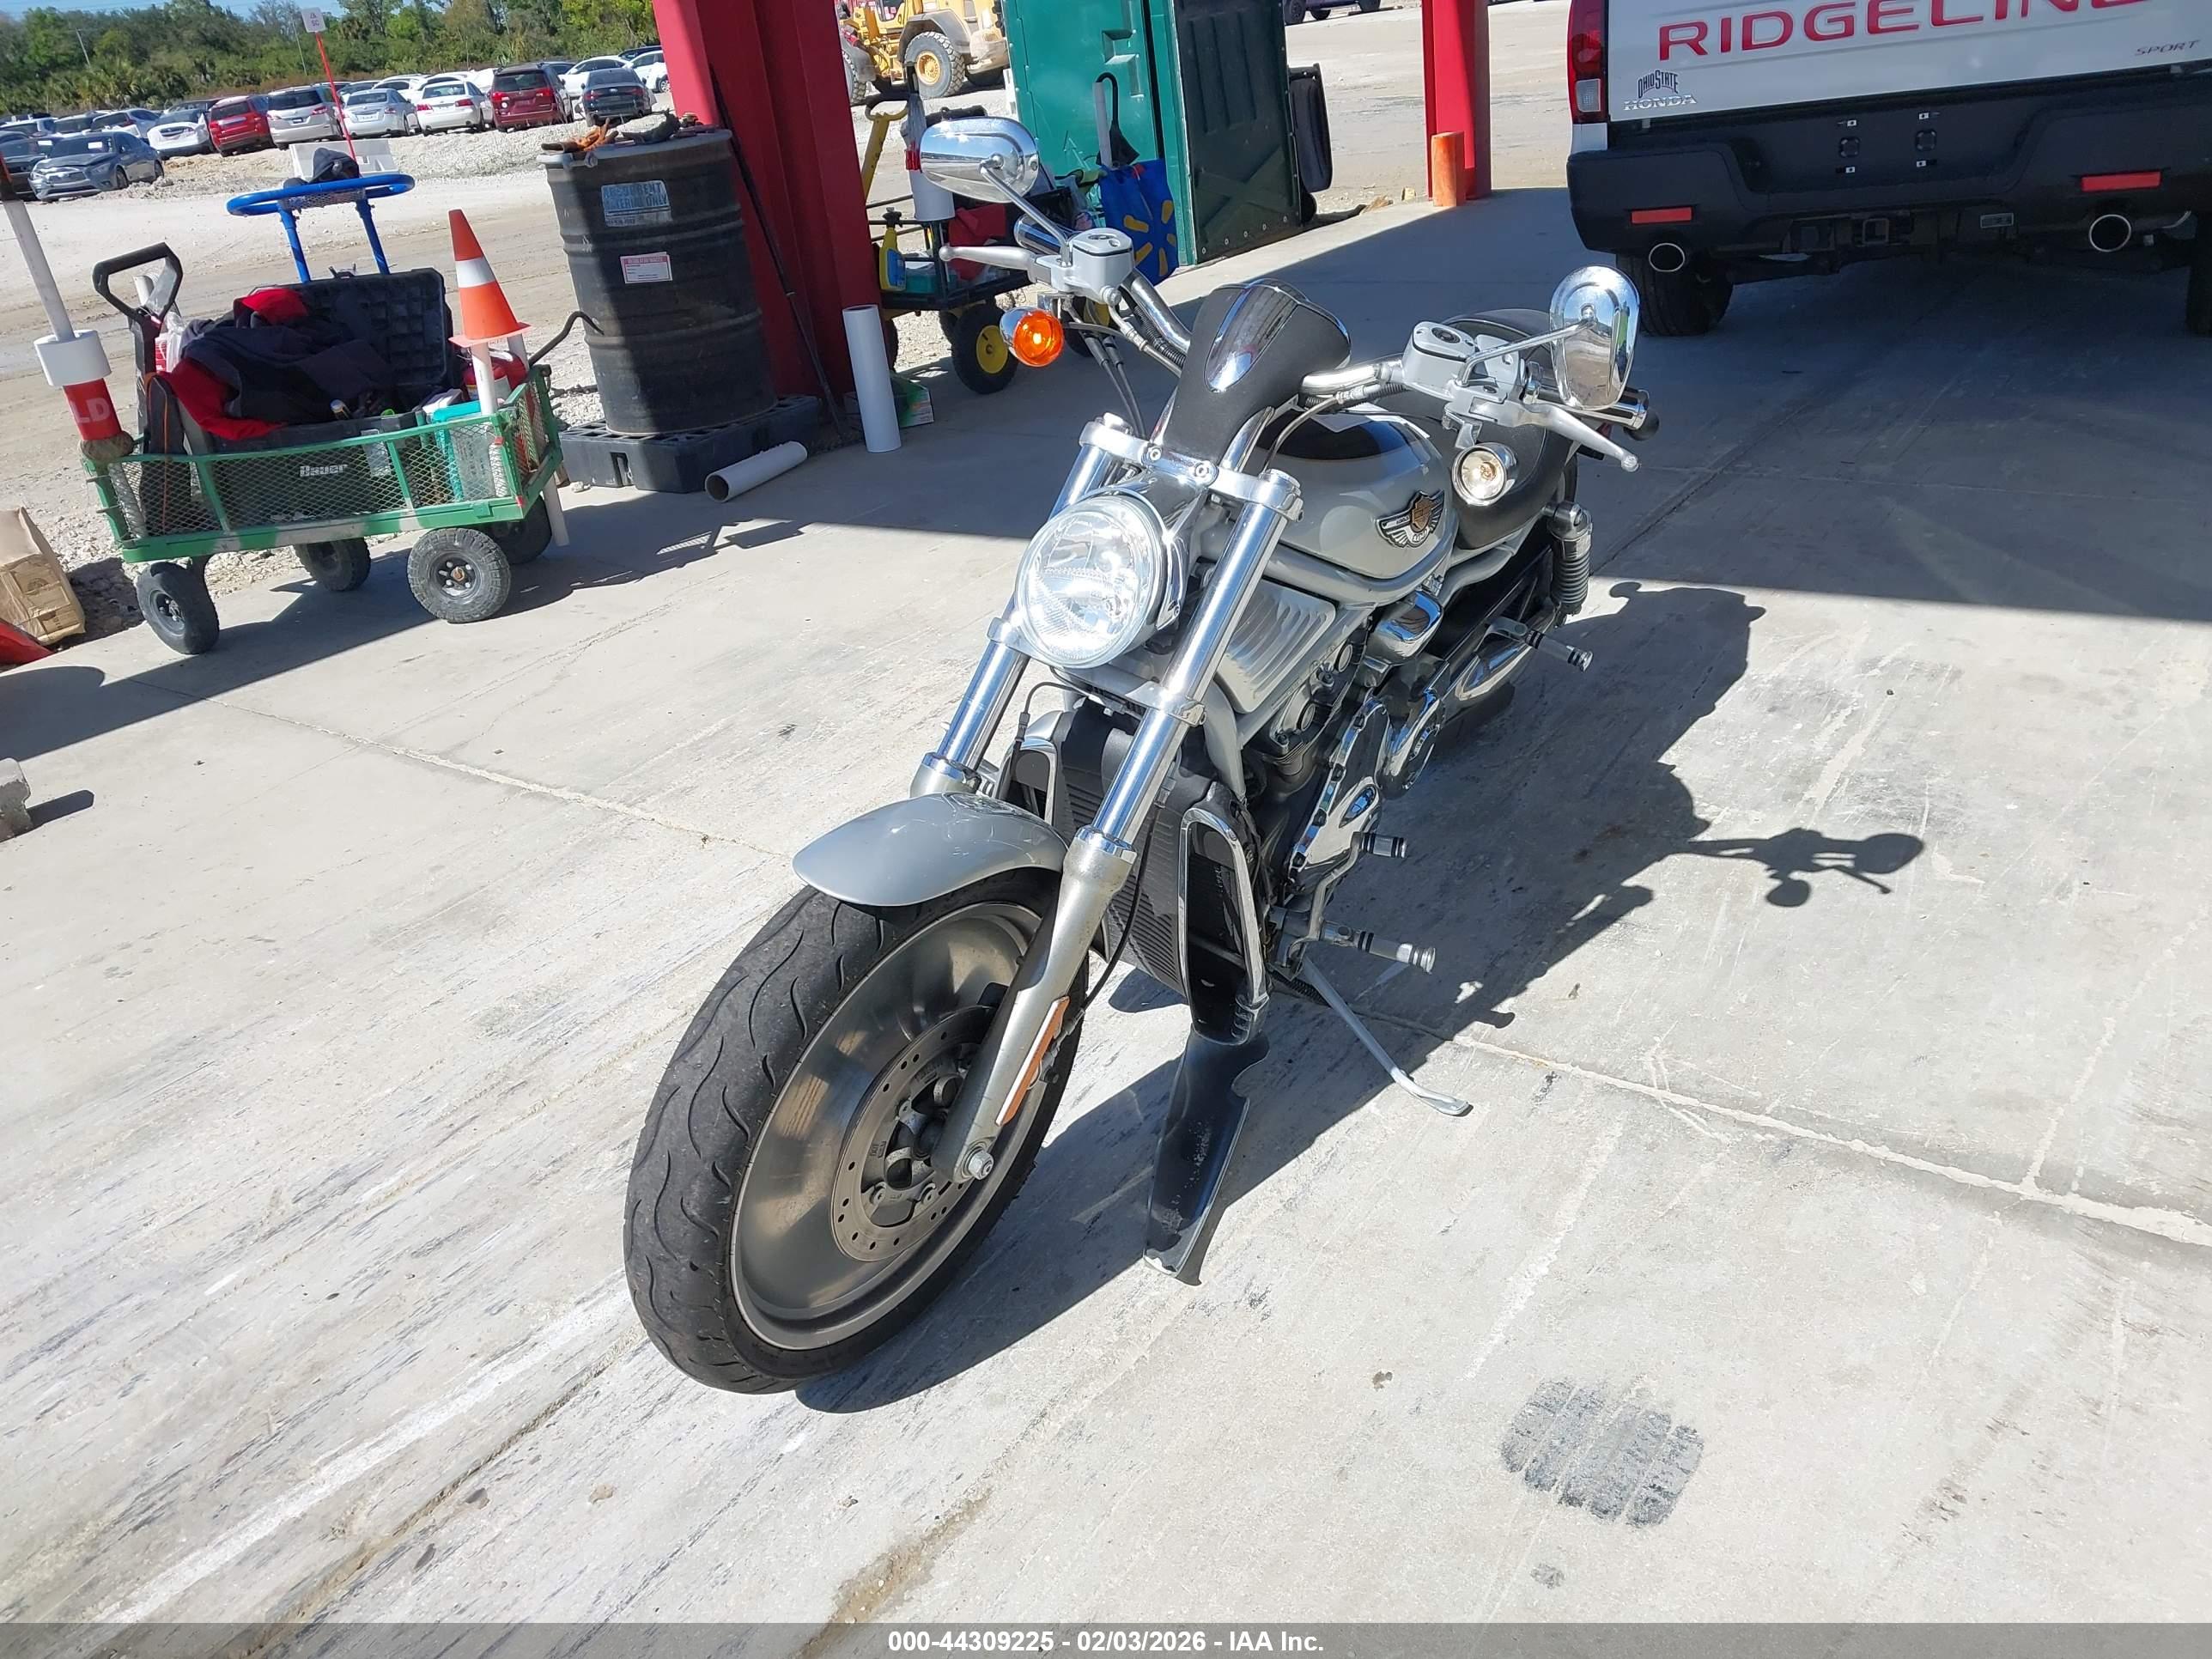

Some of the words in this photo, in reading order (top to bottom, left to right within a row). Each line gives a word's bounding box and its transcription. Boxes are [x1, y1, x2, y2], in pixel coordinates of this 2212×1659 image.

[1659, 0, 2147, 61] RIDGELI
[2135, 40, 2201, 57] SPORT
[1622, 94, 1698, 111] HONDA
